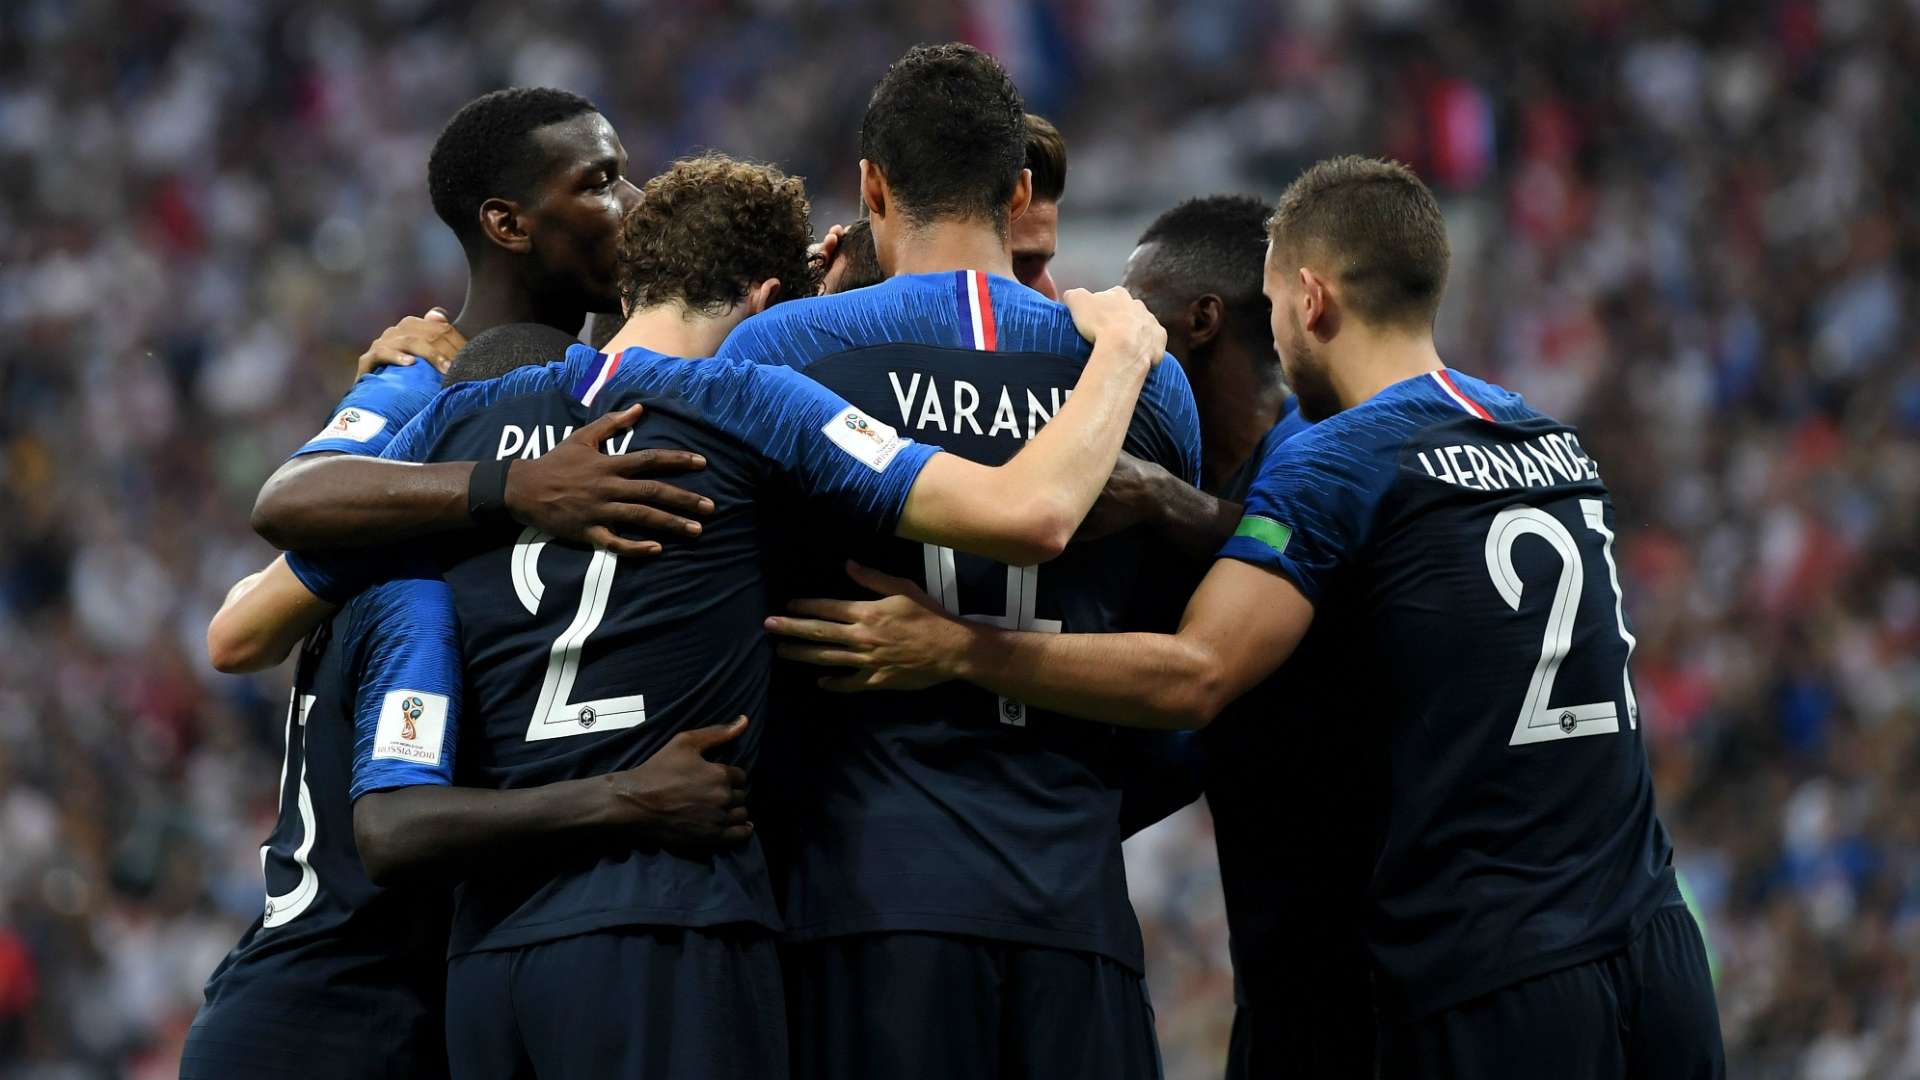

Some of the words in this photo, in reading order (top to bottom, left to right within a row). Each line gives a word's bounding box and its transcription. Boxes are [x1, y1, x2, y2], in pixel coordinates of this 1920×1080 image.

[888, 372, 1074, 441] VARAN
[510, 526, 646, 742] 2
[1484, 499, 1638, 746] 21
